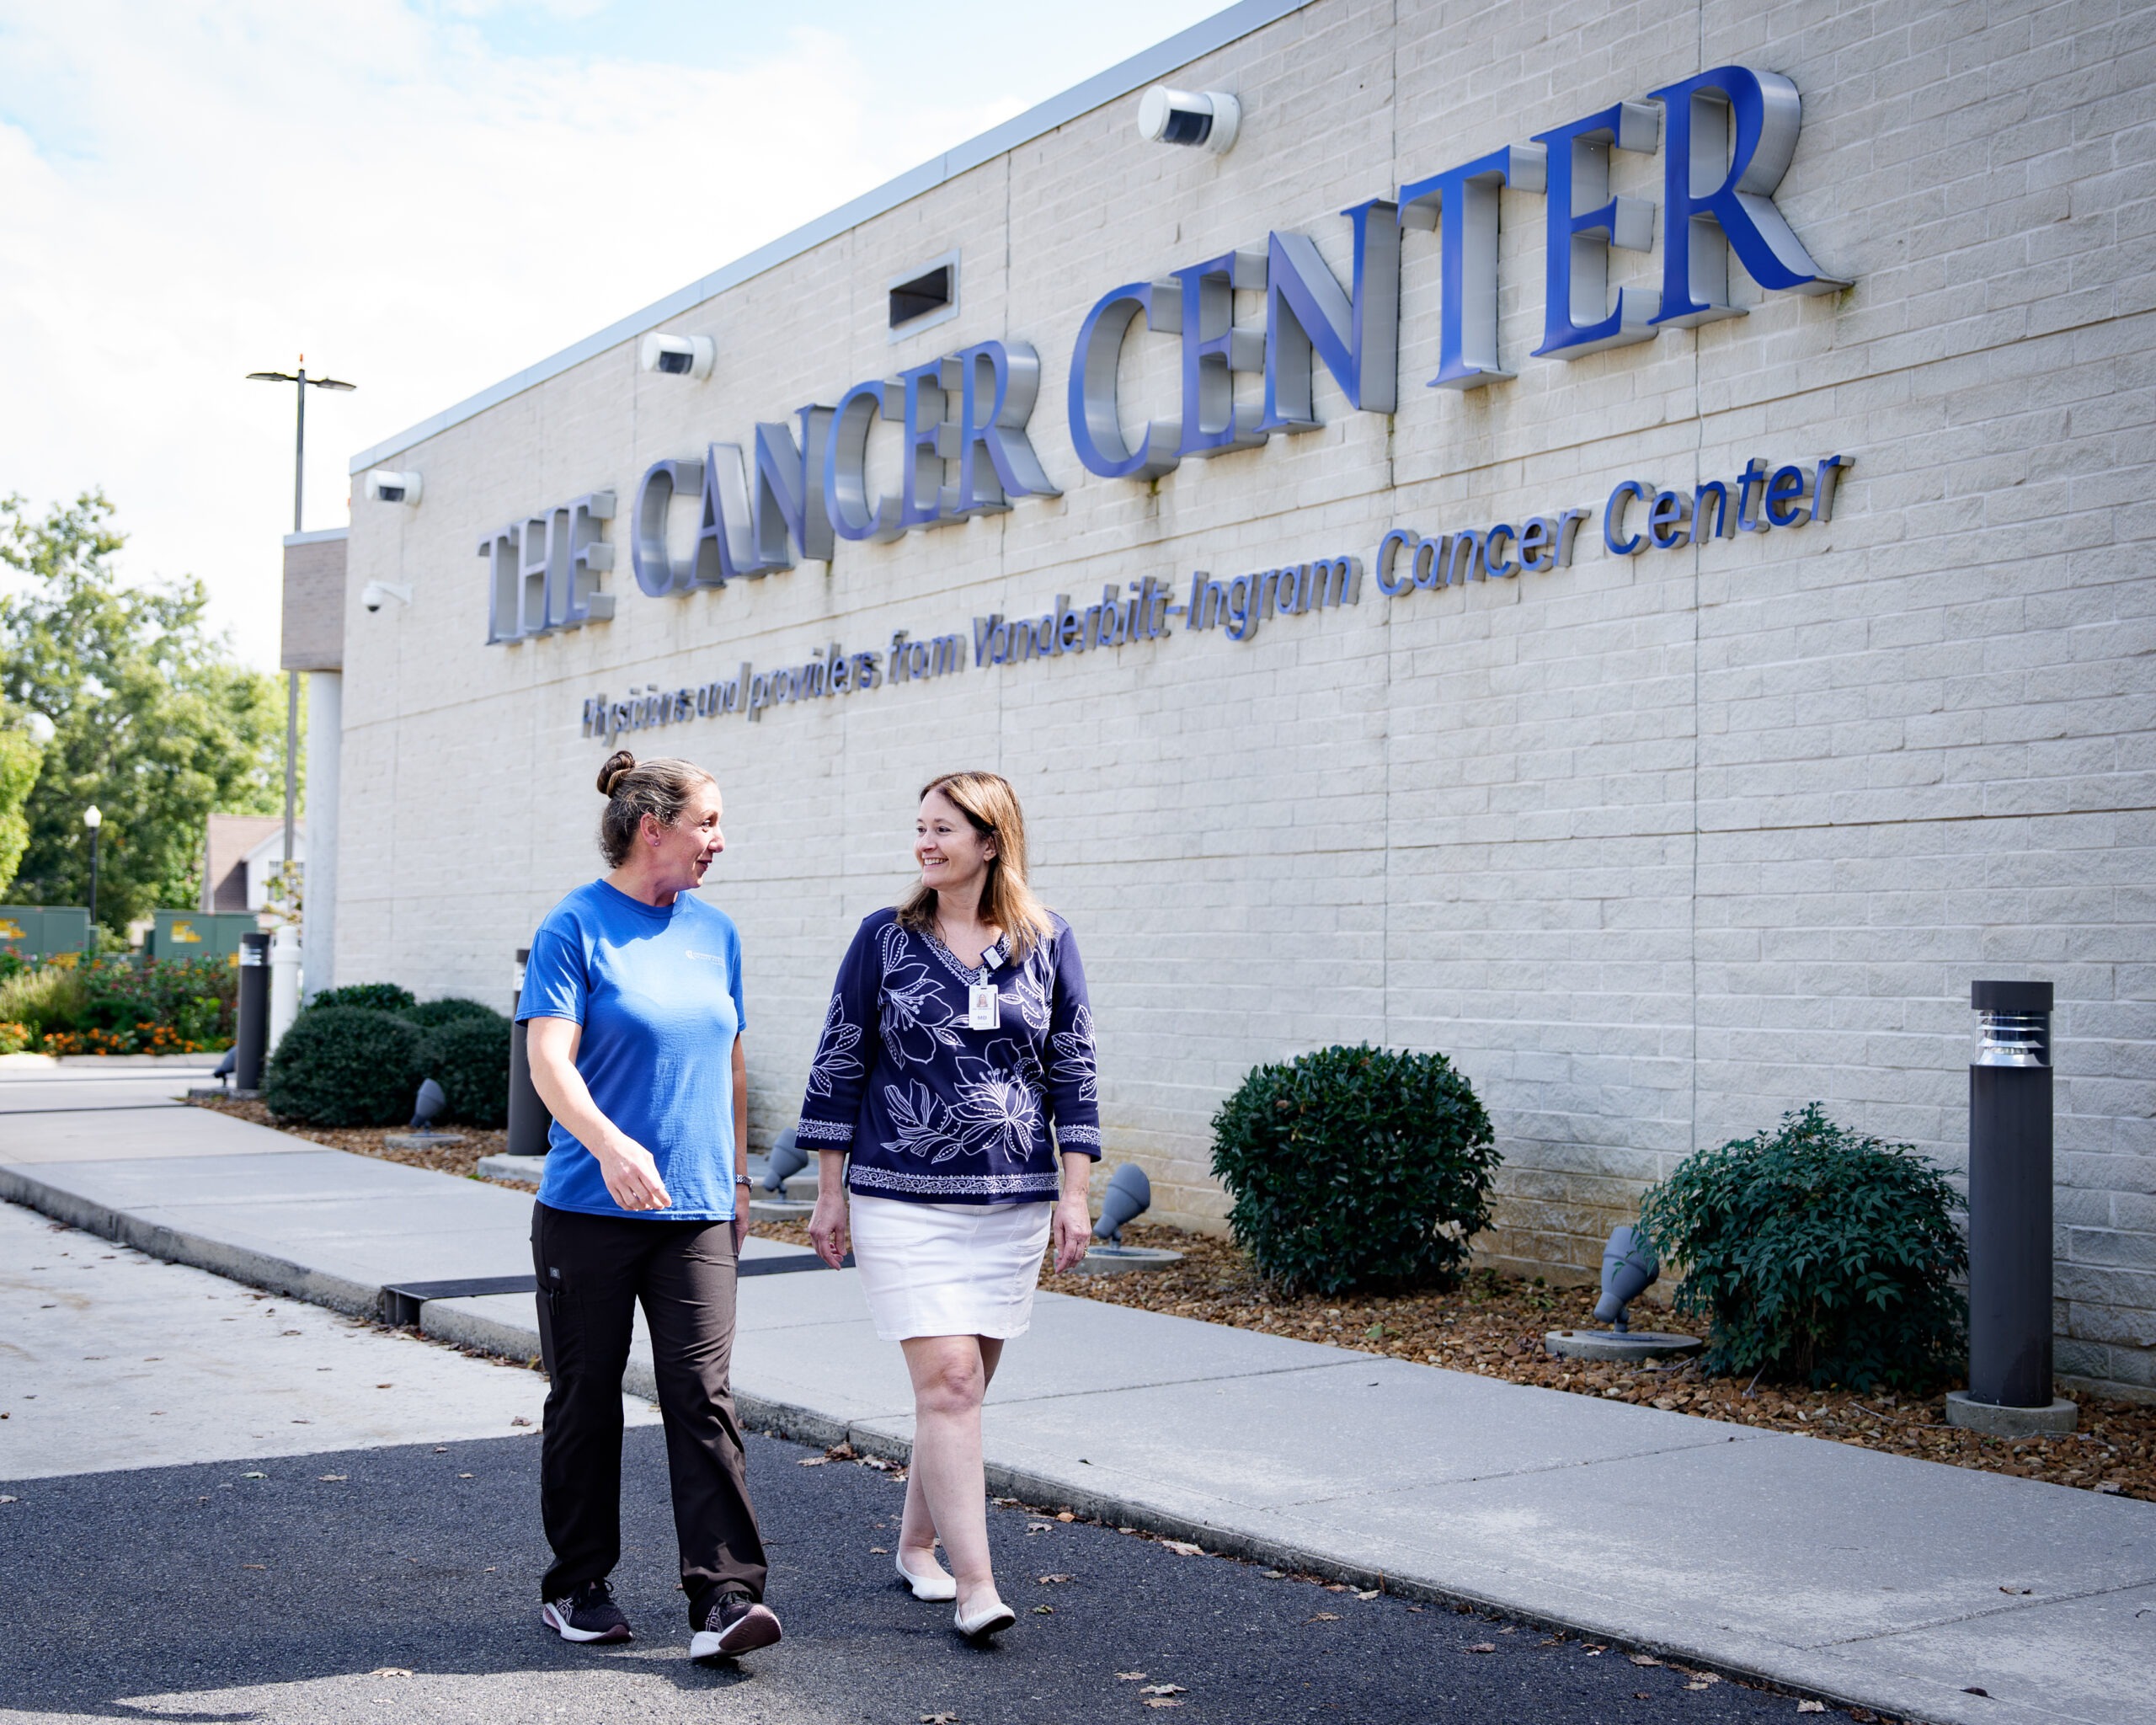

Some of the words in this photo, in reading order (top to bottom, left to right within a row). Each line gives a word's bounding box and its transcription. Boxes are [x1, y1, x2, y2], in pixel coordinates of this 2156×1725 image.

[478, 490, 617, 646] THE
[632, 340, 1065, 598] CANCER
[1067, 66, 1854, 480] CENTER
[697, 662, 752, 718] and
[747, 642, 883, 723] providers
[887, 629, 966, 685] from
[973, 556, 1363, 668] Vanderbilt-Ingram
[1376, 509, 1591, 596] Cancer
[1604, 455, 1855, 555] Center
